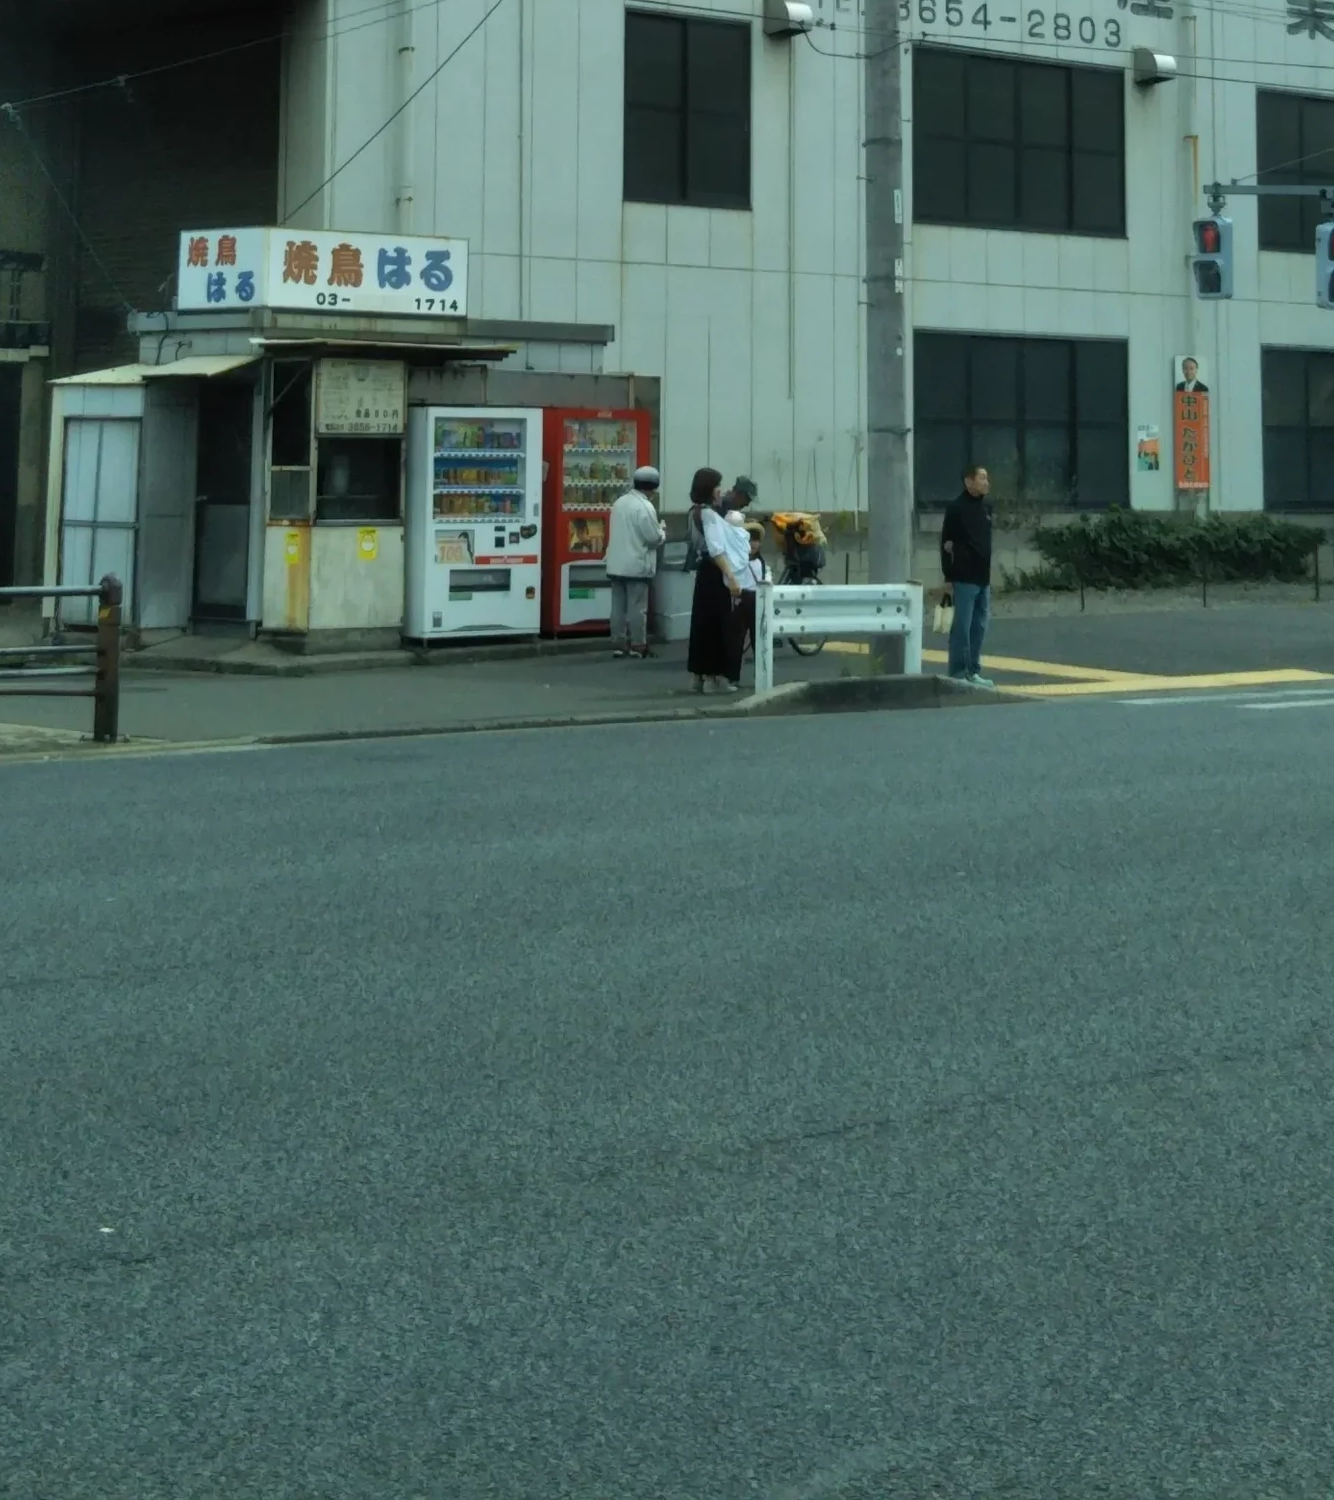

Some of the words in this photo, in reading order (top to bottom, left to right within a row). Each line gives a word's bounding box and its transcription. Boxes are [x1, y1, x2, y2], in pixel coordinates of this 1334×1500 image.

[187, 235, 237, 267] 焼鳥
[282, 240, 453, 292] 焼鳥はる
[207, 271, 256, 303] はる
[316, 292, 351, 307] 03-
[415, 298, 459, 311] 1714
